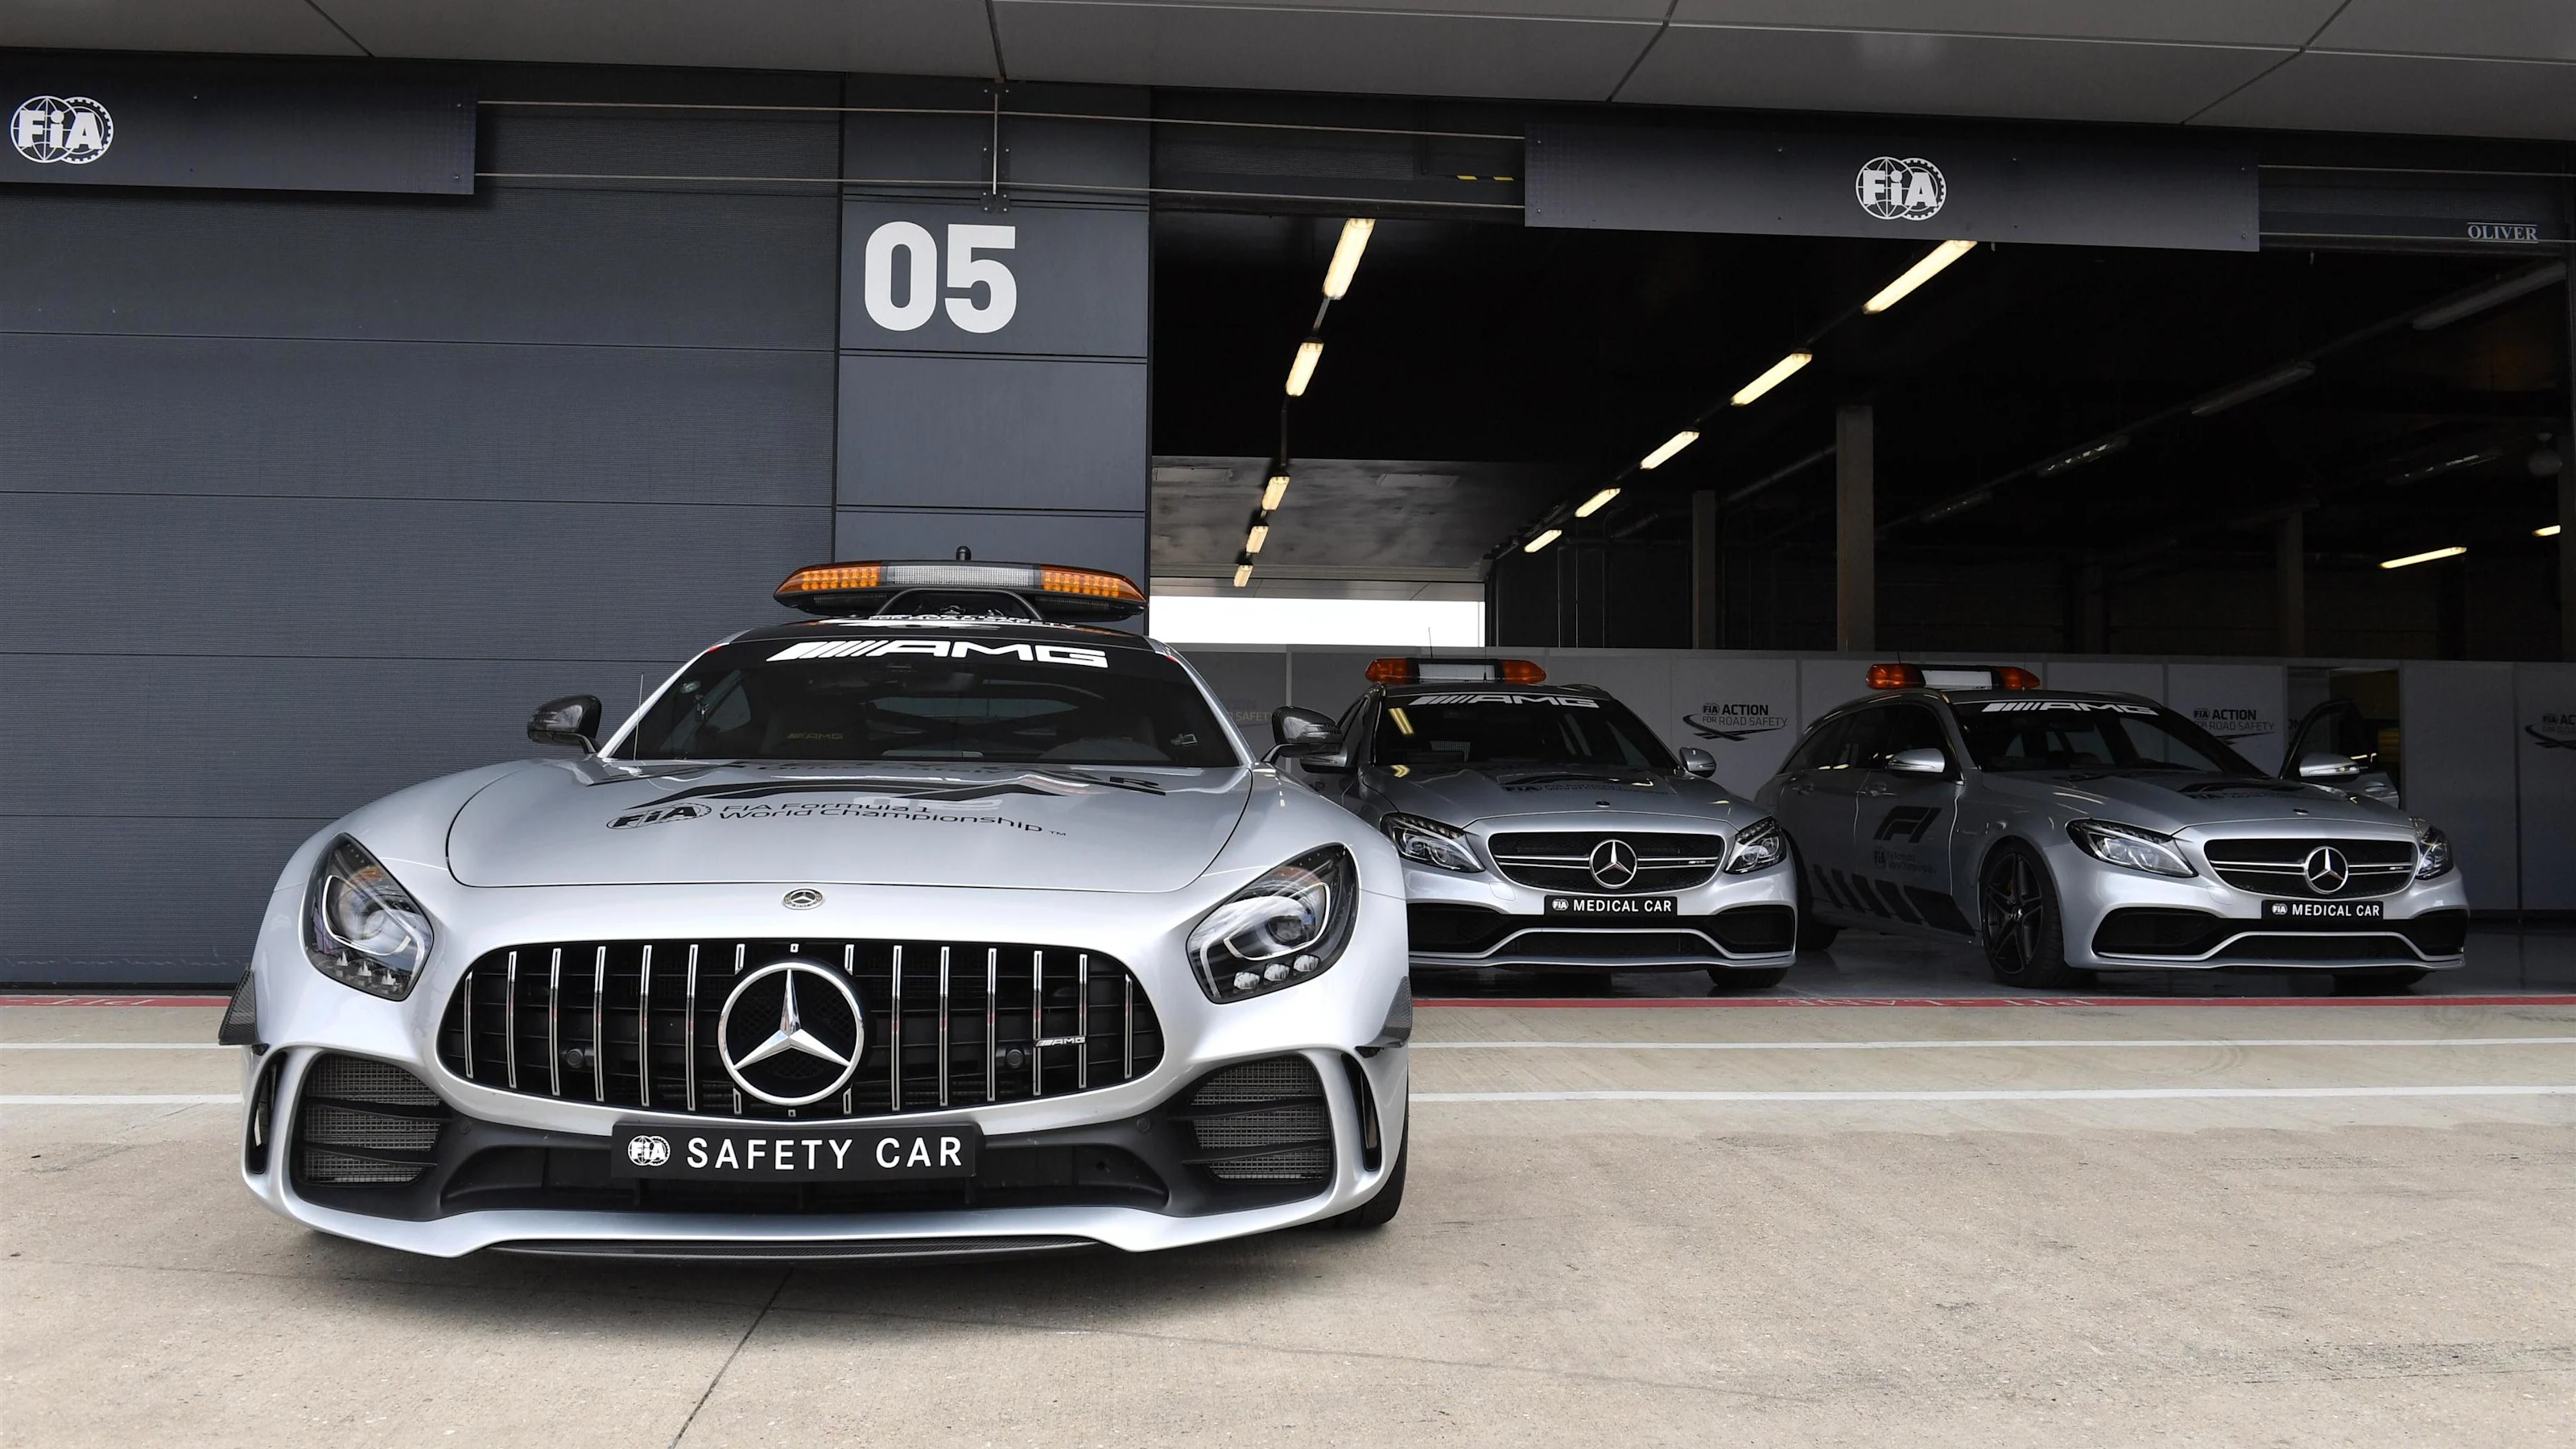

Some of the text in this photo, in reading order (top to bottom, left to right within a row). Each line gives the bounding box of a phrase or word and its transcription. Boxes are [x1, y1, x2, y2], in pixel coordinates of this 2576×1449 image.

[2467, 224, 2538, 242] OLIVER
[865, 220, 1018, 334] 05
[865, 639, 1108, 668] AMG
[1473, 694, 1600, 709] AMG
[2037, 701, 2161, 716] AMG
[1721, 704, 1769, 716] ACTION
[2212, 709, 2257, 720] ACTION
[1719, 717, 1747, 726] ROAD
[1749, 717, 1788, 727] SAFETY
[2209, 721, 2236, 731] ROAD
[2238, 721, 2275, 731] SAFETY
[722, 803, 770, 812] FIA
[779, 803, 909, 813] Formula
[719, 808, 811, 819] World
[819, 808, 1043, 832] Championship
[1573, 899, 1640, 913] MEDICAL
[1644, 900, 1672, 913] CAR
[2292, 903, 2351, 917] MEDICAL
[2356, 904, 2380, 917] CAR
[1050, 1035, 1087, 1046] AMG
[687, 1137, 854, 1170] SAFETY
[876, 1135, 963, 1168] CAR
